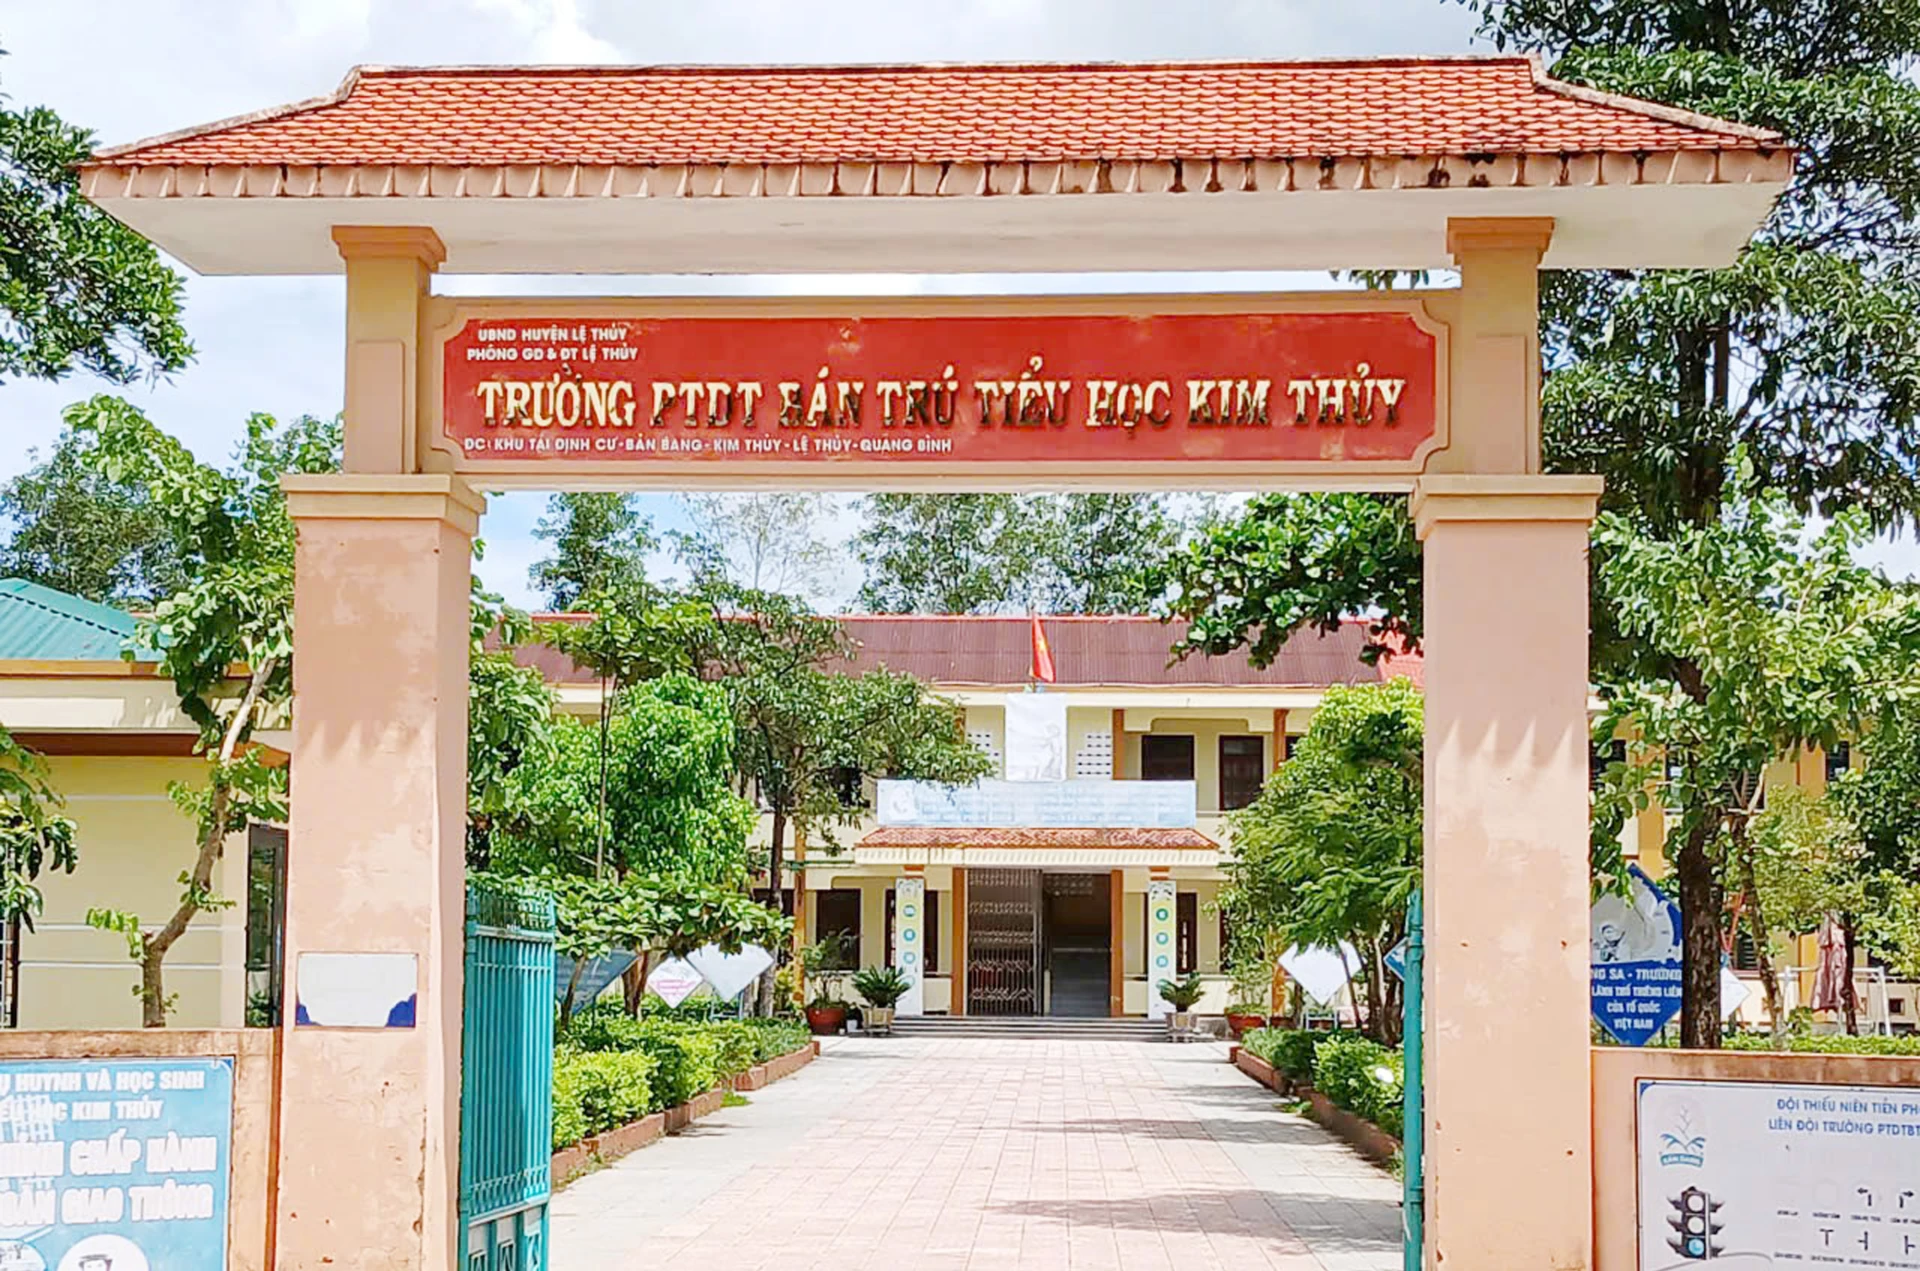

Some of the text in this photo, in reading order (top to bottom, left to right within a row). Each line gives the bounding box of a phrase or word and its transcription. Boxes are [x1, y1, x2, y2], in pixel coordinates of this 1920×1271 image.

[478, 322, 627, 344] UBND HUYỆN LỆ THỦY
[522, 348, 544, 361] GD
[582, 344, 597, 363] LỆ
[602, 342, 638, 361] THỦY
[477, 356, 1406, 440] TRƯỜNG PTDT BÁN TRÚ TIỂU HỌC KIM THỦY
[494, 438, 524, 450] KHU
[529, 433, 550, 451] TÁI
[555, 438, 590, 454] ĐỊNH
[714, 438, 739, 453] KIM
[15, 1072, 82, 1092] HUYNH
[86, 1067, 112, 1091] VÀ
[116, 1071, 155, 1094] HỌC
[159, 1070, 205, 1090] SINH
[71, 1101, 111, 1121] KIM
[1777, 1096, 1799, 1114] ĐỘI
[1803, 1096, 1836, 1112] THIẾU
[1840, 1098, 1867, 1113] NIÊN
[1901, 1103, 1920, 1115] PH
[1768, 1115, 1793, 1130] LIÊN
[1796, 1117, 1819, 1134] ĐỘI
[1823, 1118, 1874, 1134] TRƯỜNG
